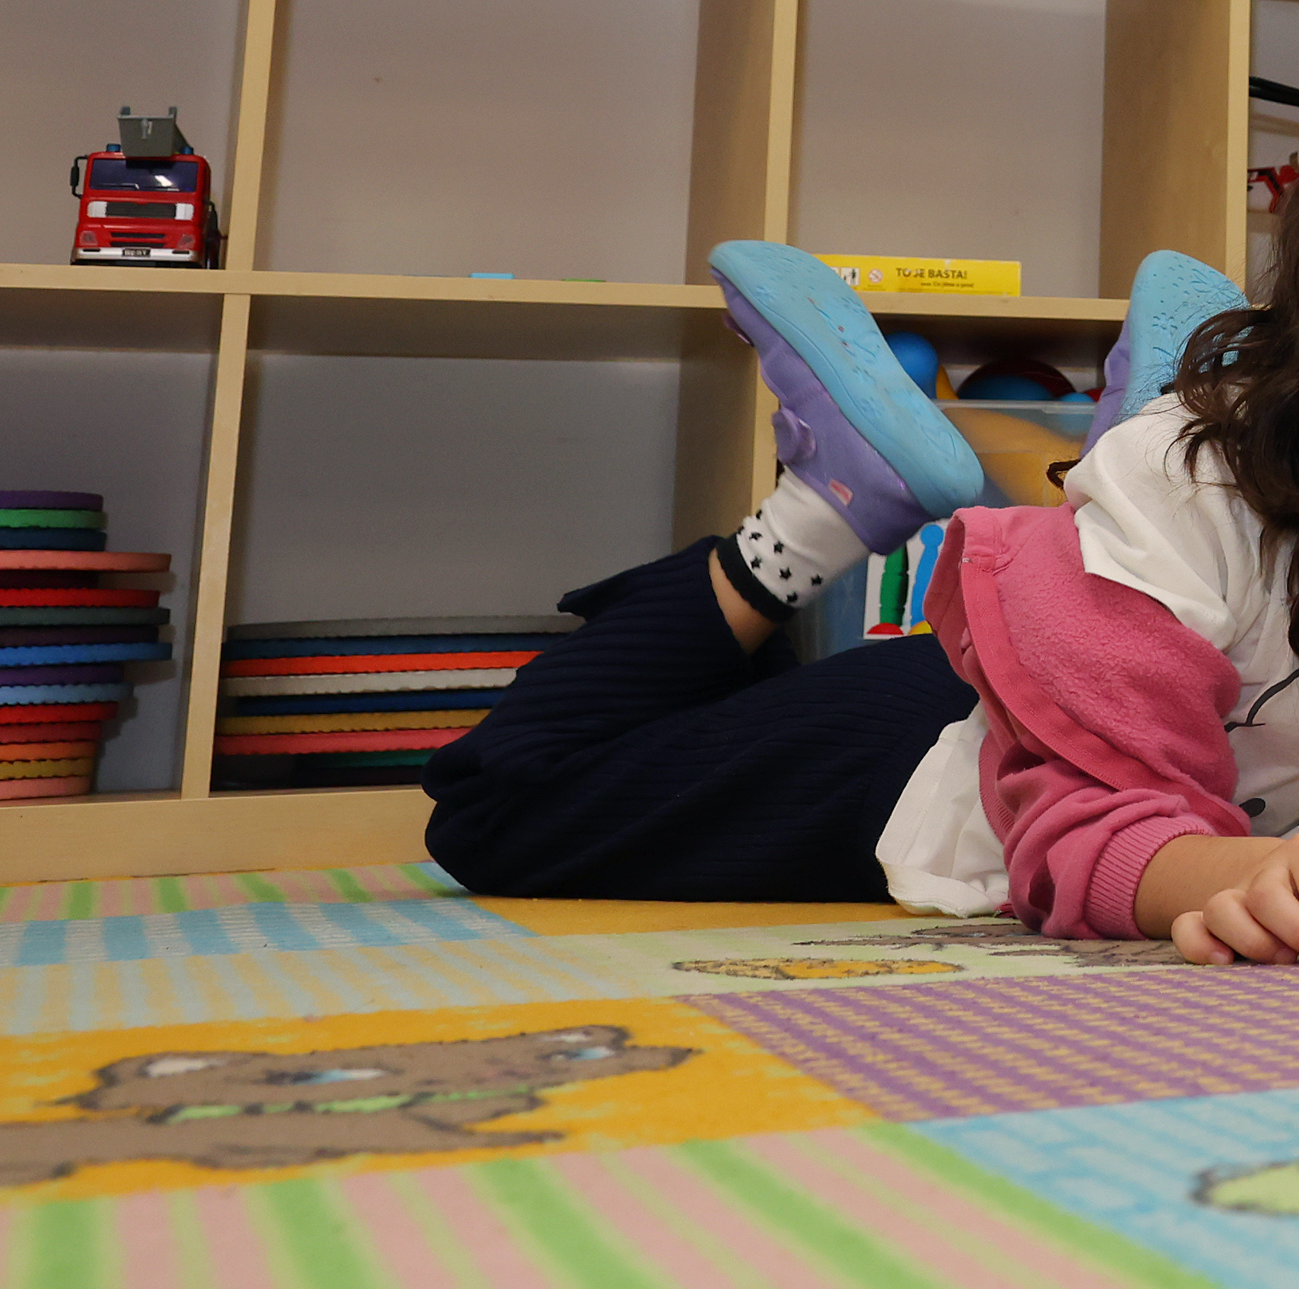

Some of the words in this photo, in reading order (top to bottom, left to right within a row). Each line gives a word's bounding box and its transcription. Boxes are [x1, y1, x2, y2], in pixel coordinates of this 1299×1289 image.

[896, 267, 912, 278] TO
[913, 269, 925, 279] JE
[927, 269, 968, 280] BASTA!
